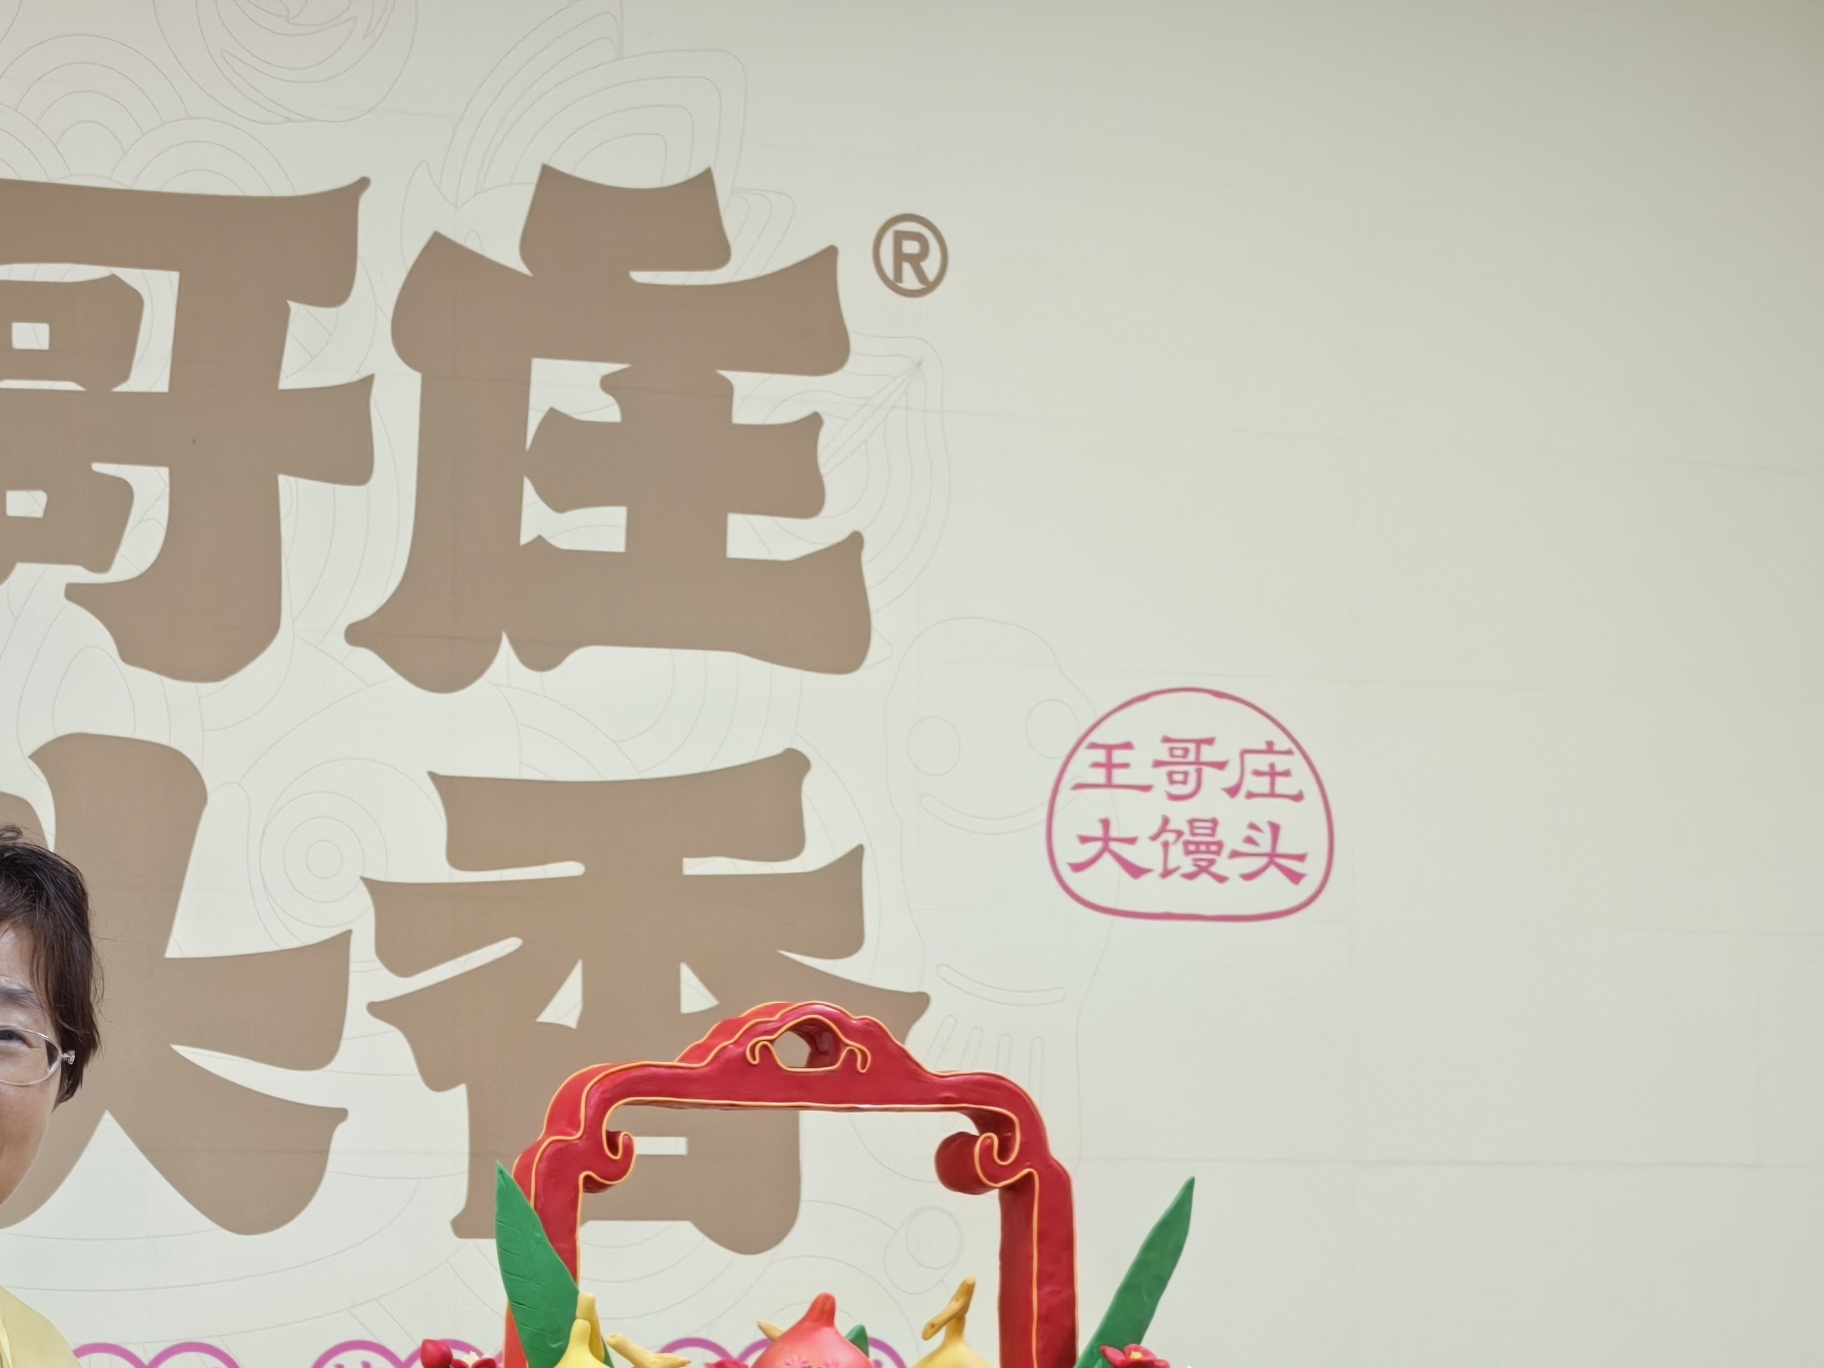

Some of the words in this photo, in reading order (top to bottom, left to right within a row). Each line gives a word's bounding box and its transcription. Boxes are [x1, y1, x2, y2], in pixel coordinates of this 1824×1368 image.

[1070, 735, 1305, 803] 王哥庄
[1066, 814, 1308, 886] 大馒头
